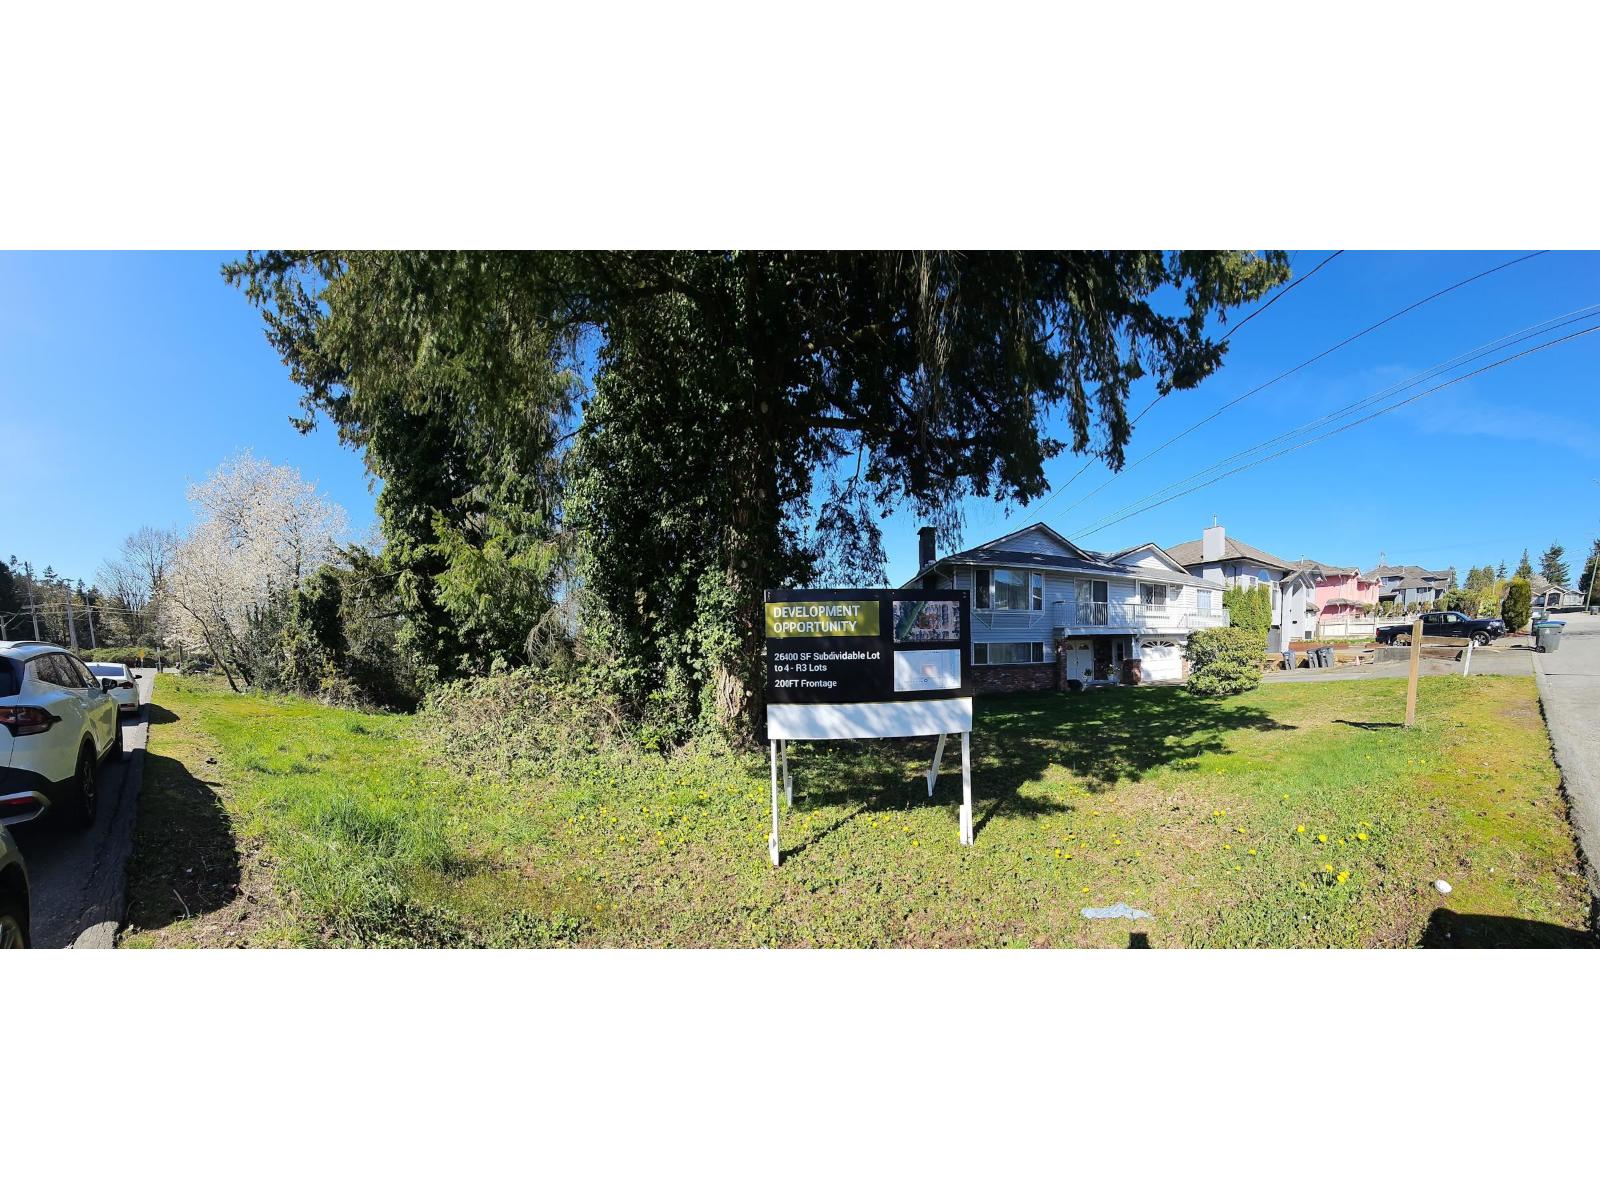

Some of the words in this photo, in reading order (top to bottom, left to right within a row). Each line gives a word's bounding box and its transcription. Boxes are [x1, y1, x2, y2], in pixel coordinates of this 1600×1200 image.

[774, 605, 860, 618] DEVELOPMENT
[774, 621, 857, 633] OPPORTUNITY
[774, 653, 798, 661] 26400
[814, 651, 865, 660] Subdividable
[867, 651, 880, 660] Lot
[801, 679, 837, 688] Frontage
